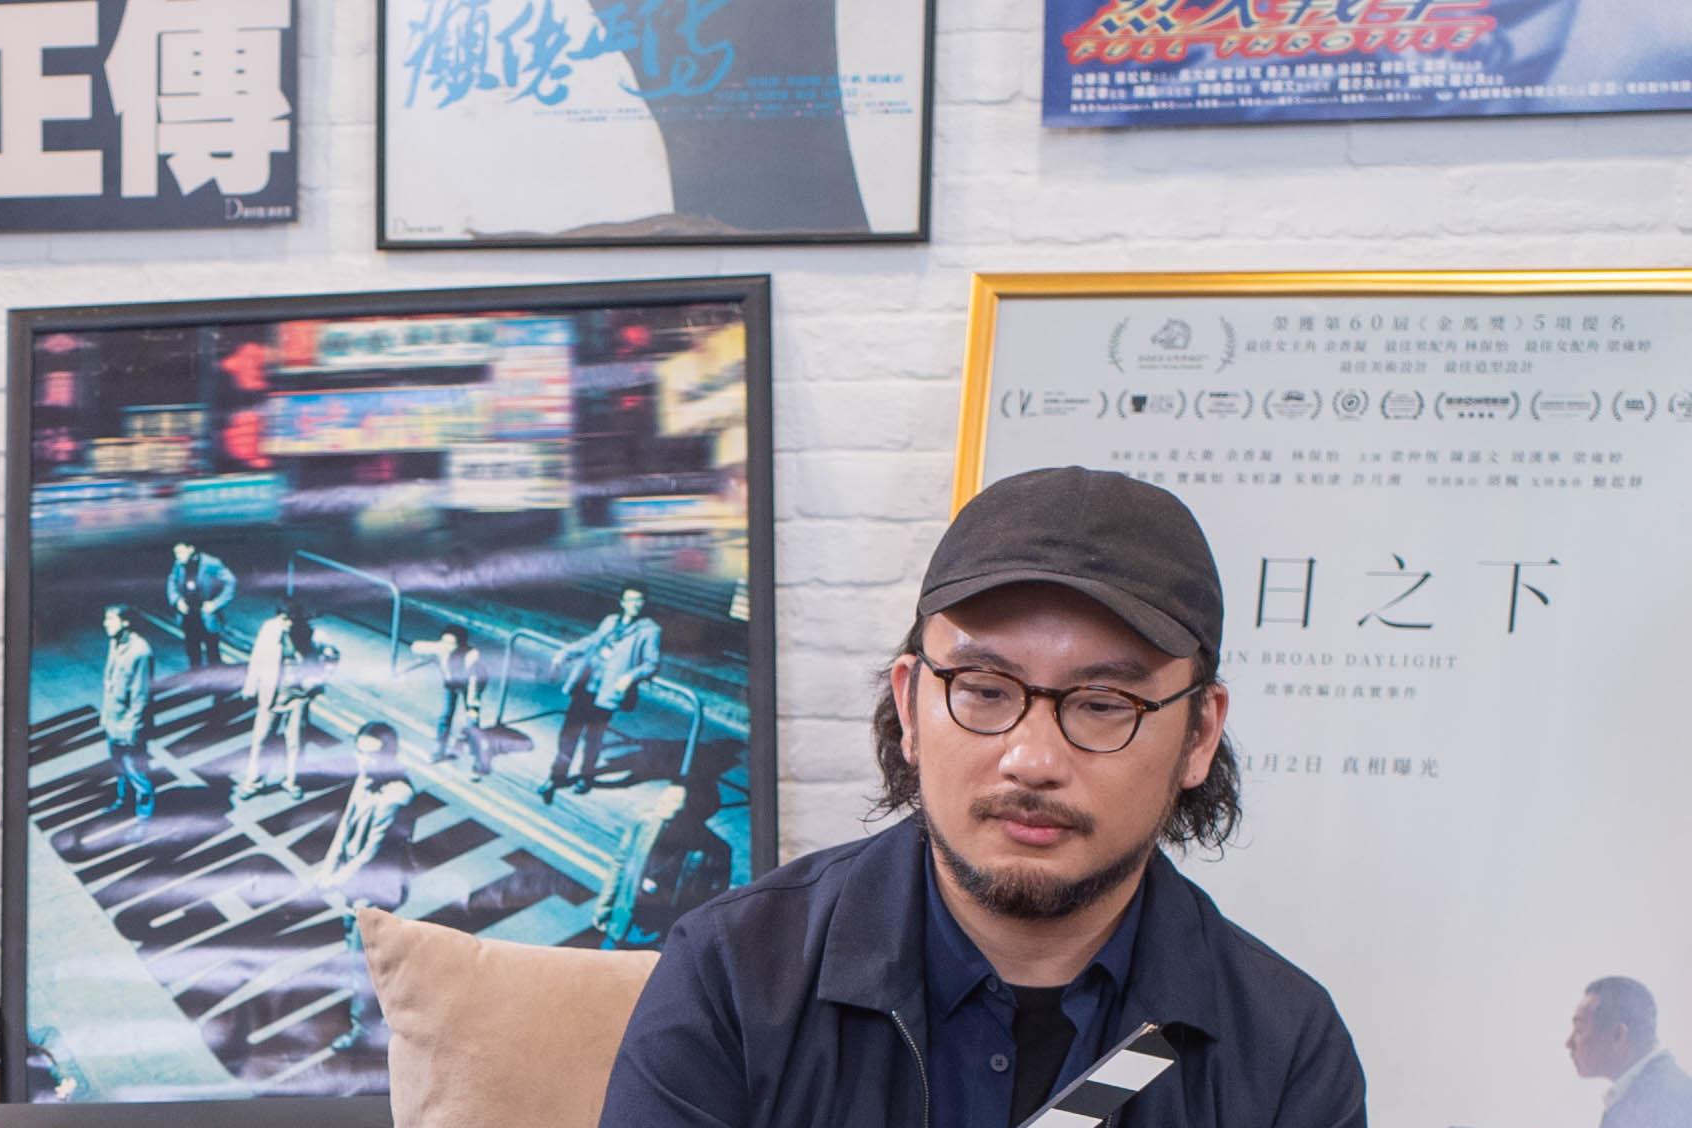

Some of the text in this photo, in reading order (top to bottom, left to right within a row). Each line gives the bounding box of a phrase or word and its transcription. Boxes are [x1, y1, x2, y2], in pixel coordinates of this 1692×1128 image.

[1256, 552, 1562, 634] 日之下
[1260, 651, 1334, 668] BROAD
[1344, 652, 1461, 670] DAYLIGHT
